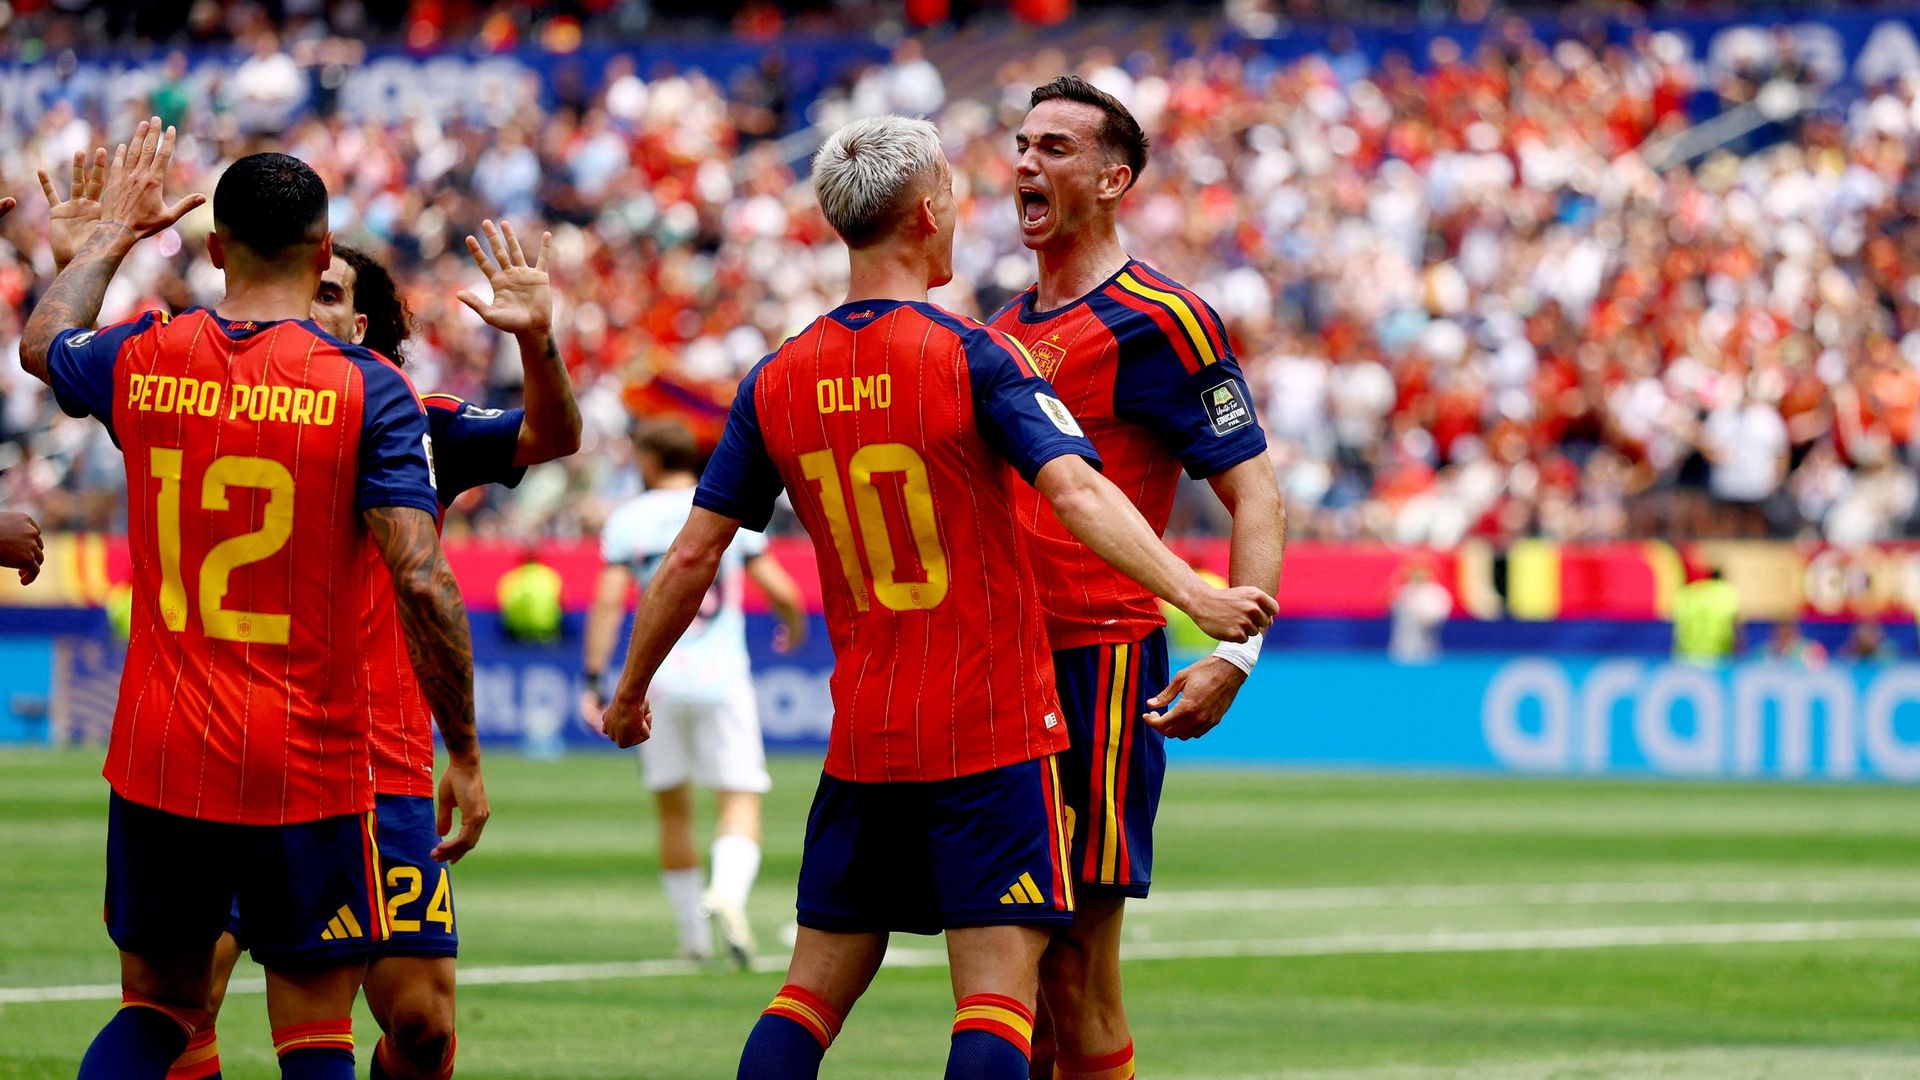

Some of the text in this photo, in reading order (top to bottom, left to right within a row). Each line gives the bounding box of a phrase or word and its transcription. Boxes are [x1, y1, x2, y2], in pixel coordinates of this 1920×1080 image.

[128, 374, 336, 426] PEDRO PORRO
[817, 374, 891, 414] OLMO
[150, 447, 295, 645] 12
[798, 443, 948, 612] 10
[386, 866, 454, 934] 24
